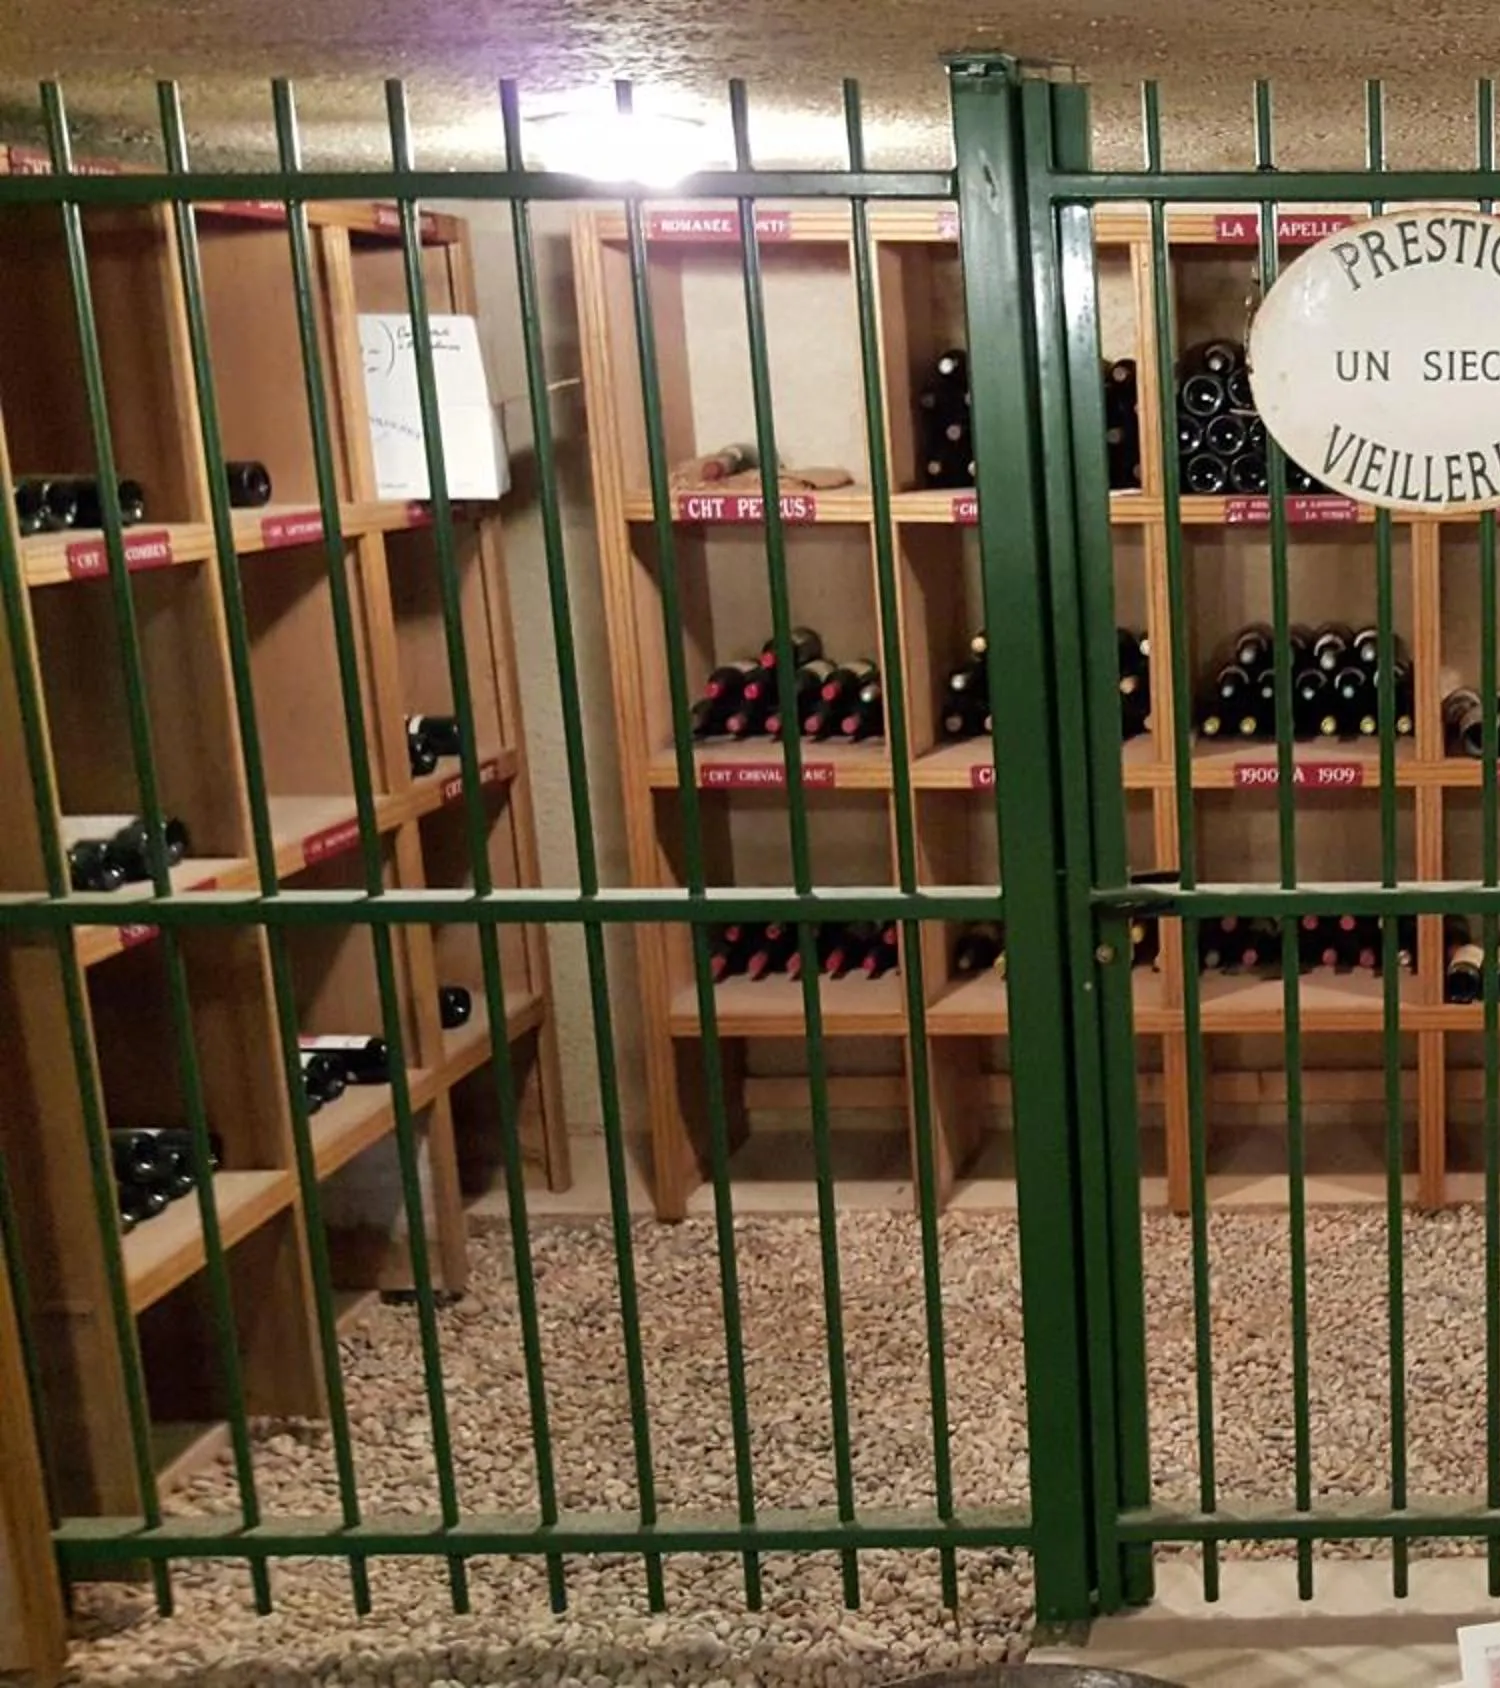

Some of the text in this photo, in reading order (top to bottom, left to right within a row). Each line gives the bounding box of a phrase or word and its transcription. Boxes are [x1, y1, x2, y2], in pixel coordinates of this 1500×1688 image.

[1221, 221, 1344, 237] LA APELLE
[1335, 350, 1391, 382] UN
[688, 498, 807, 518] CHT PEUS
[1241, 767, 1279, 783] 1900
[1318, 767, 1355, 784] 1909
